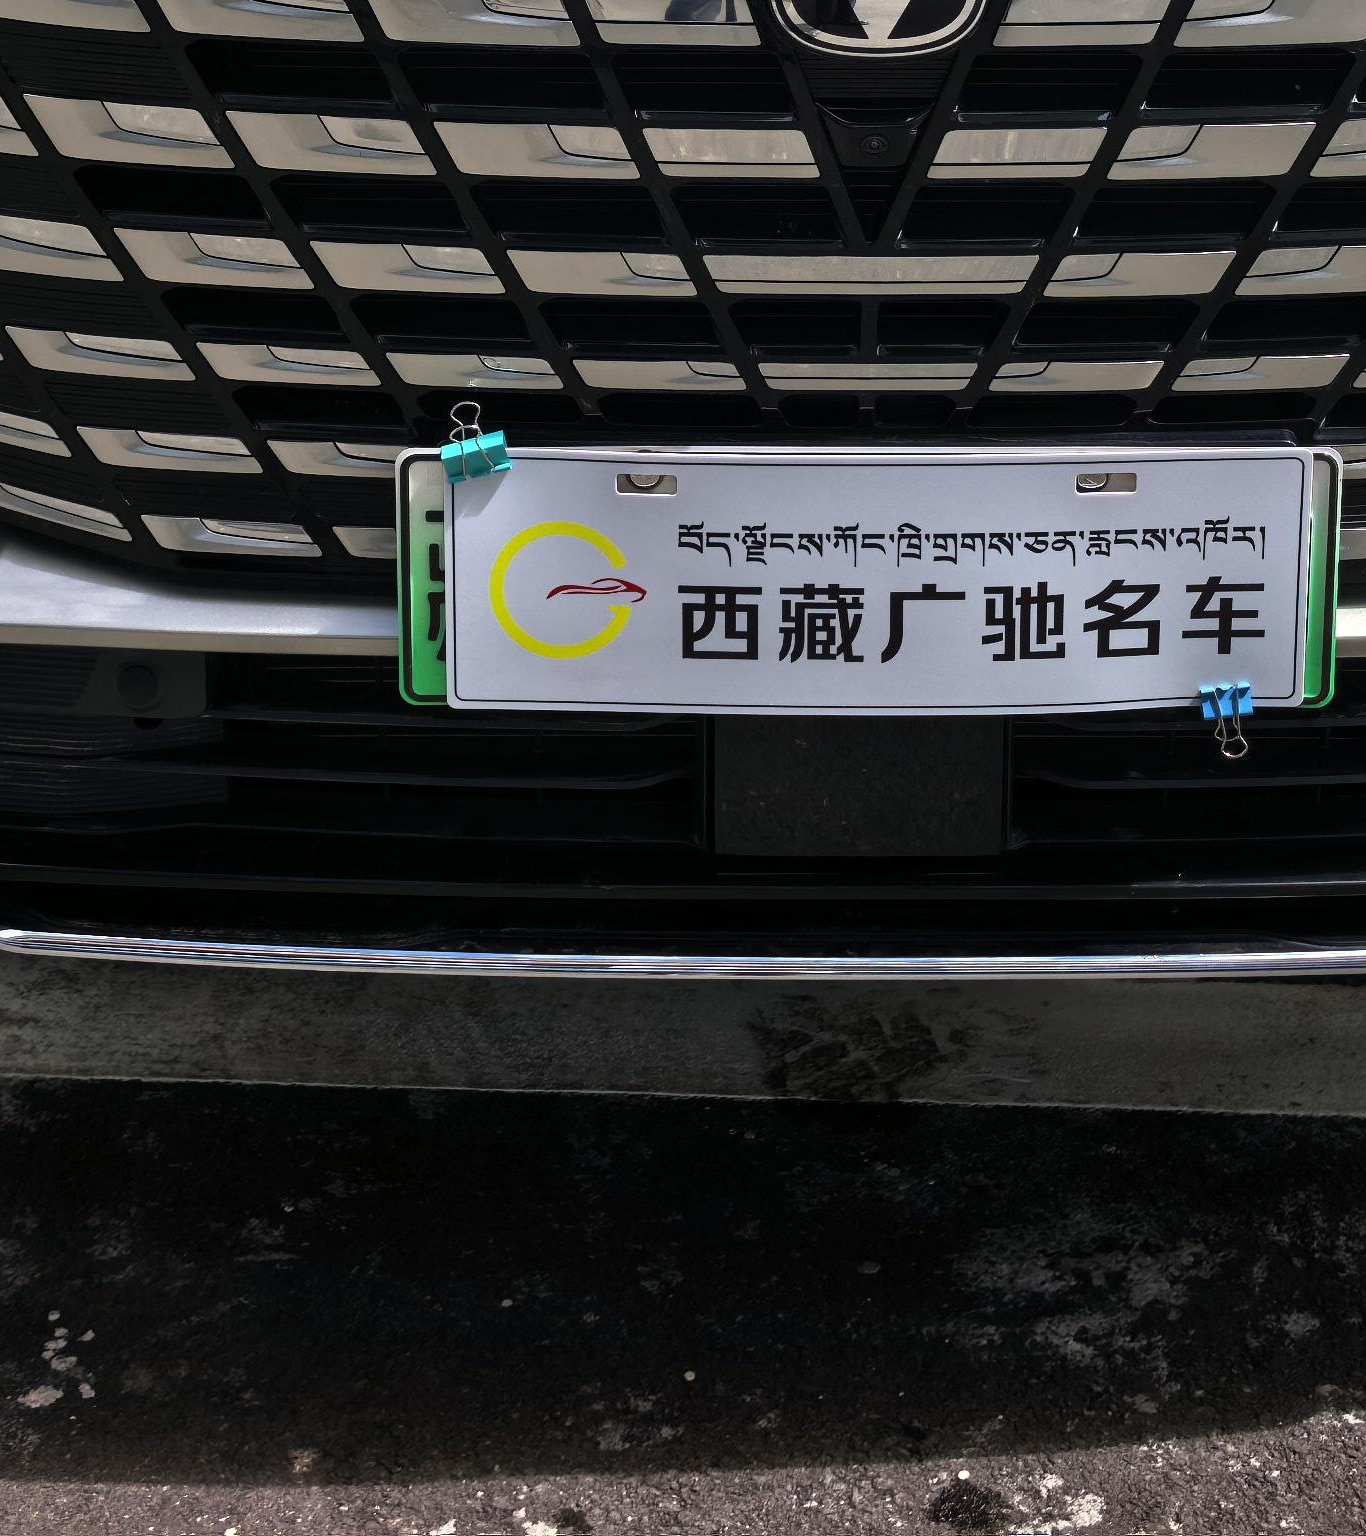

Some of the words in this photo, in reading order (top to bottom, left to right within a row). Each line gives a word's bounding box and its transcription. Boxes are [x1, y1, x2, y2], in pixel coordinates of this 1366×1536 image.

[677, 575, 1266, 664] 西藏广驰名车
